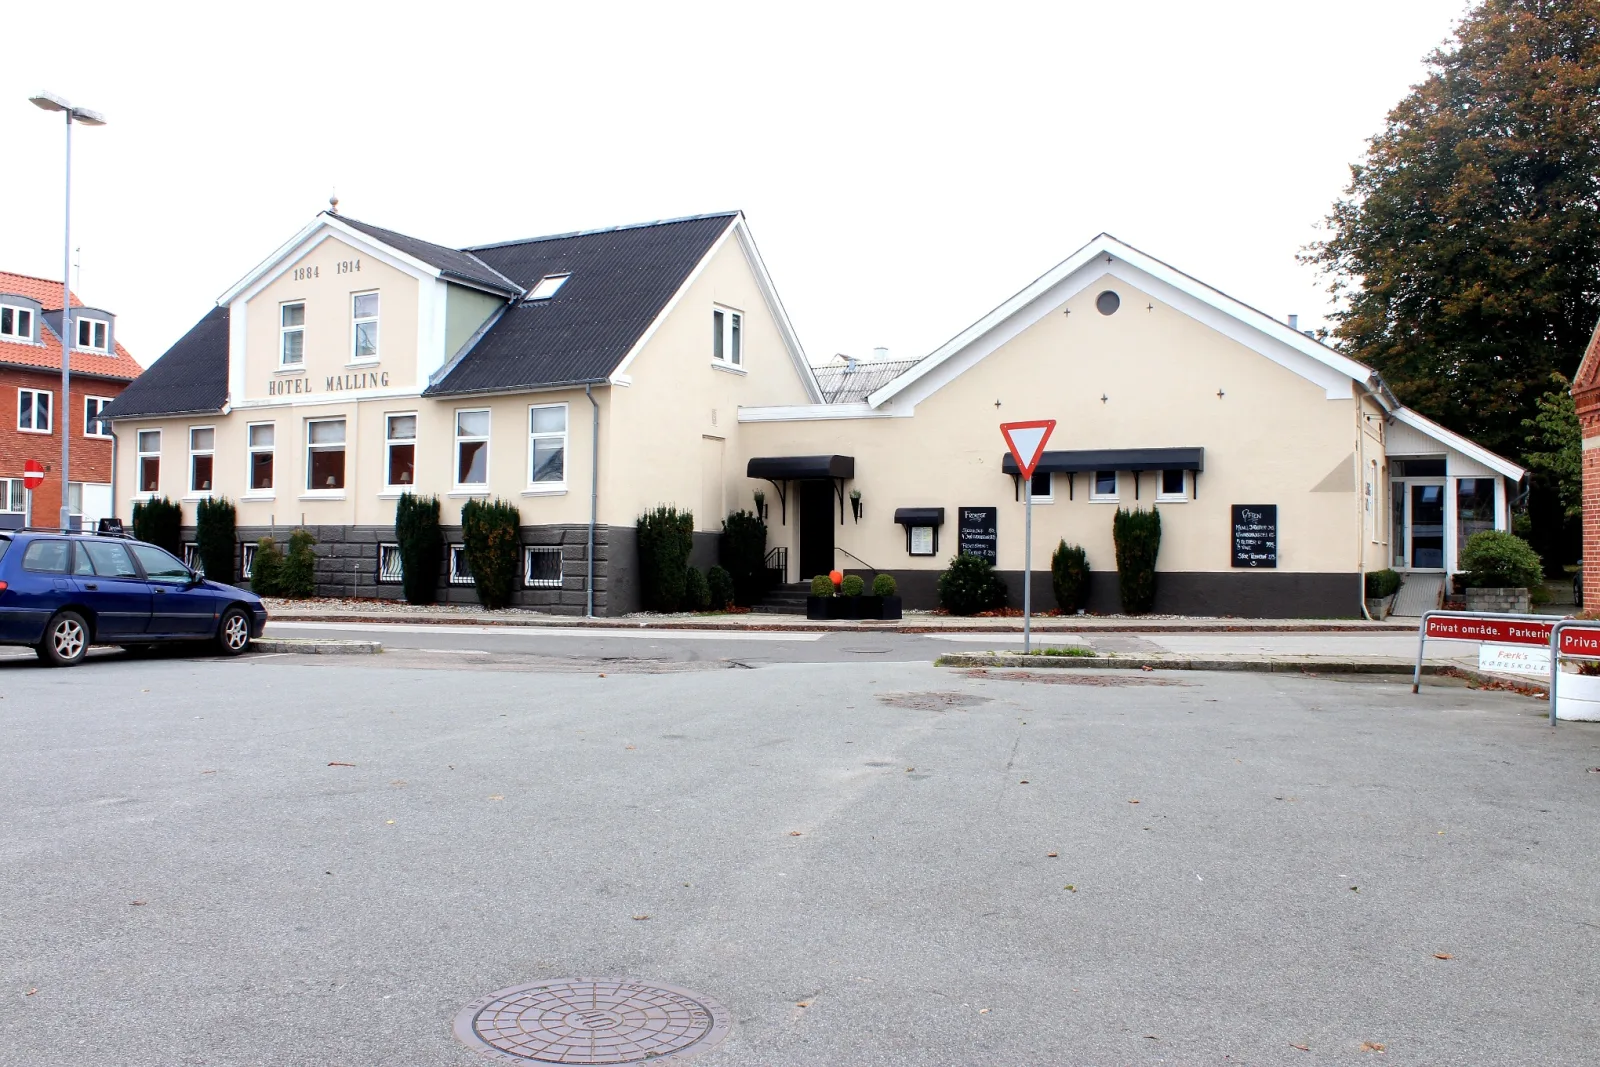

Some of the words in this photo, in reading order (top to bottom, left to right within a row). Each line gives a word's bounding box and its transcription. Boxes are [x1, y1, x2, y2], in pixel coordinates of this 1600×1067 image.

[294, 266, 320, 281] 1884
[336, 259, 361, 275] 1914
[269, 378, 312, 396] HOTEL
[326, 371, 389, 391] MALLING
[1430, 622, 1458, 633] Privat
[1461, 624, 1501, 636] område.
[1509, 627, 1550, 639] Parkerin
[1565, 635, 1600, 648] Priva
[1497, 650, 1529, 660] Færk's
[1481, 660, 1547, 671] KØRESKOLE
